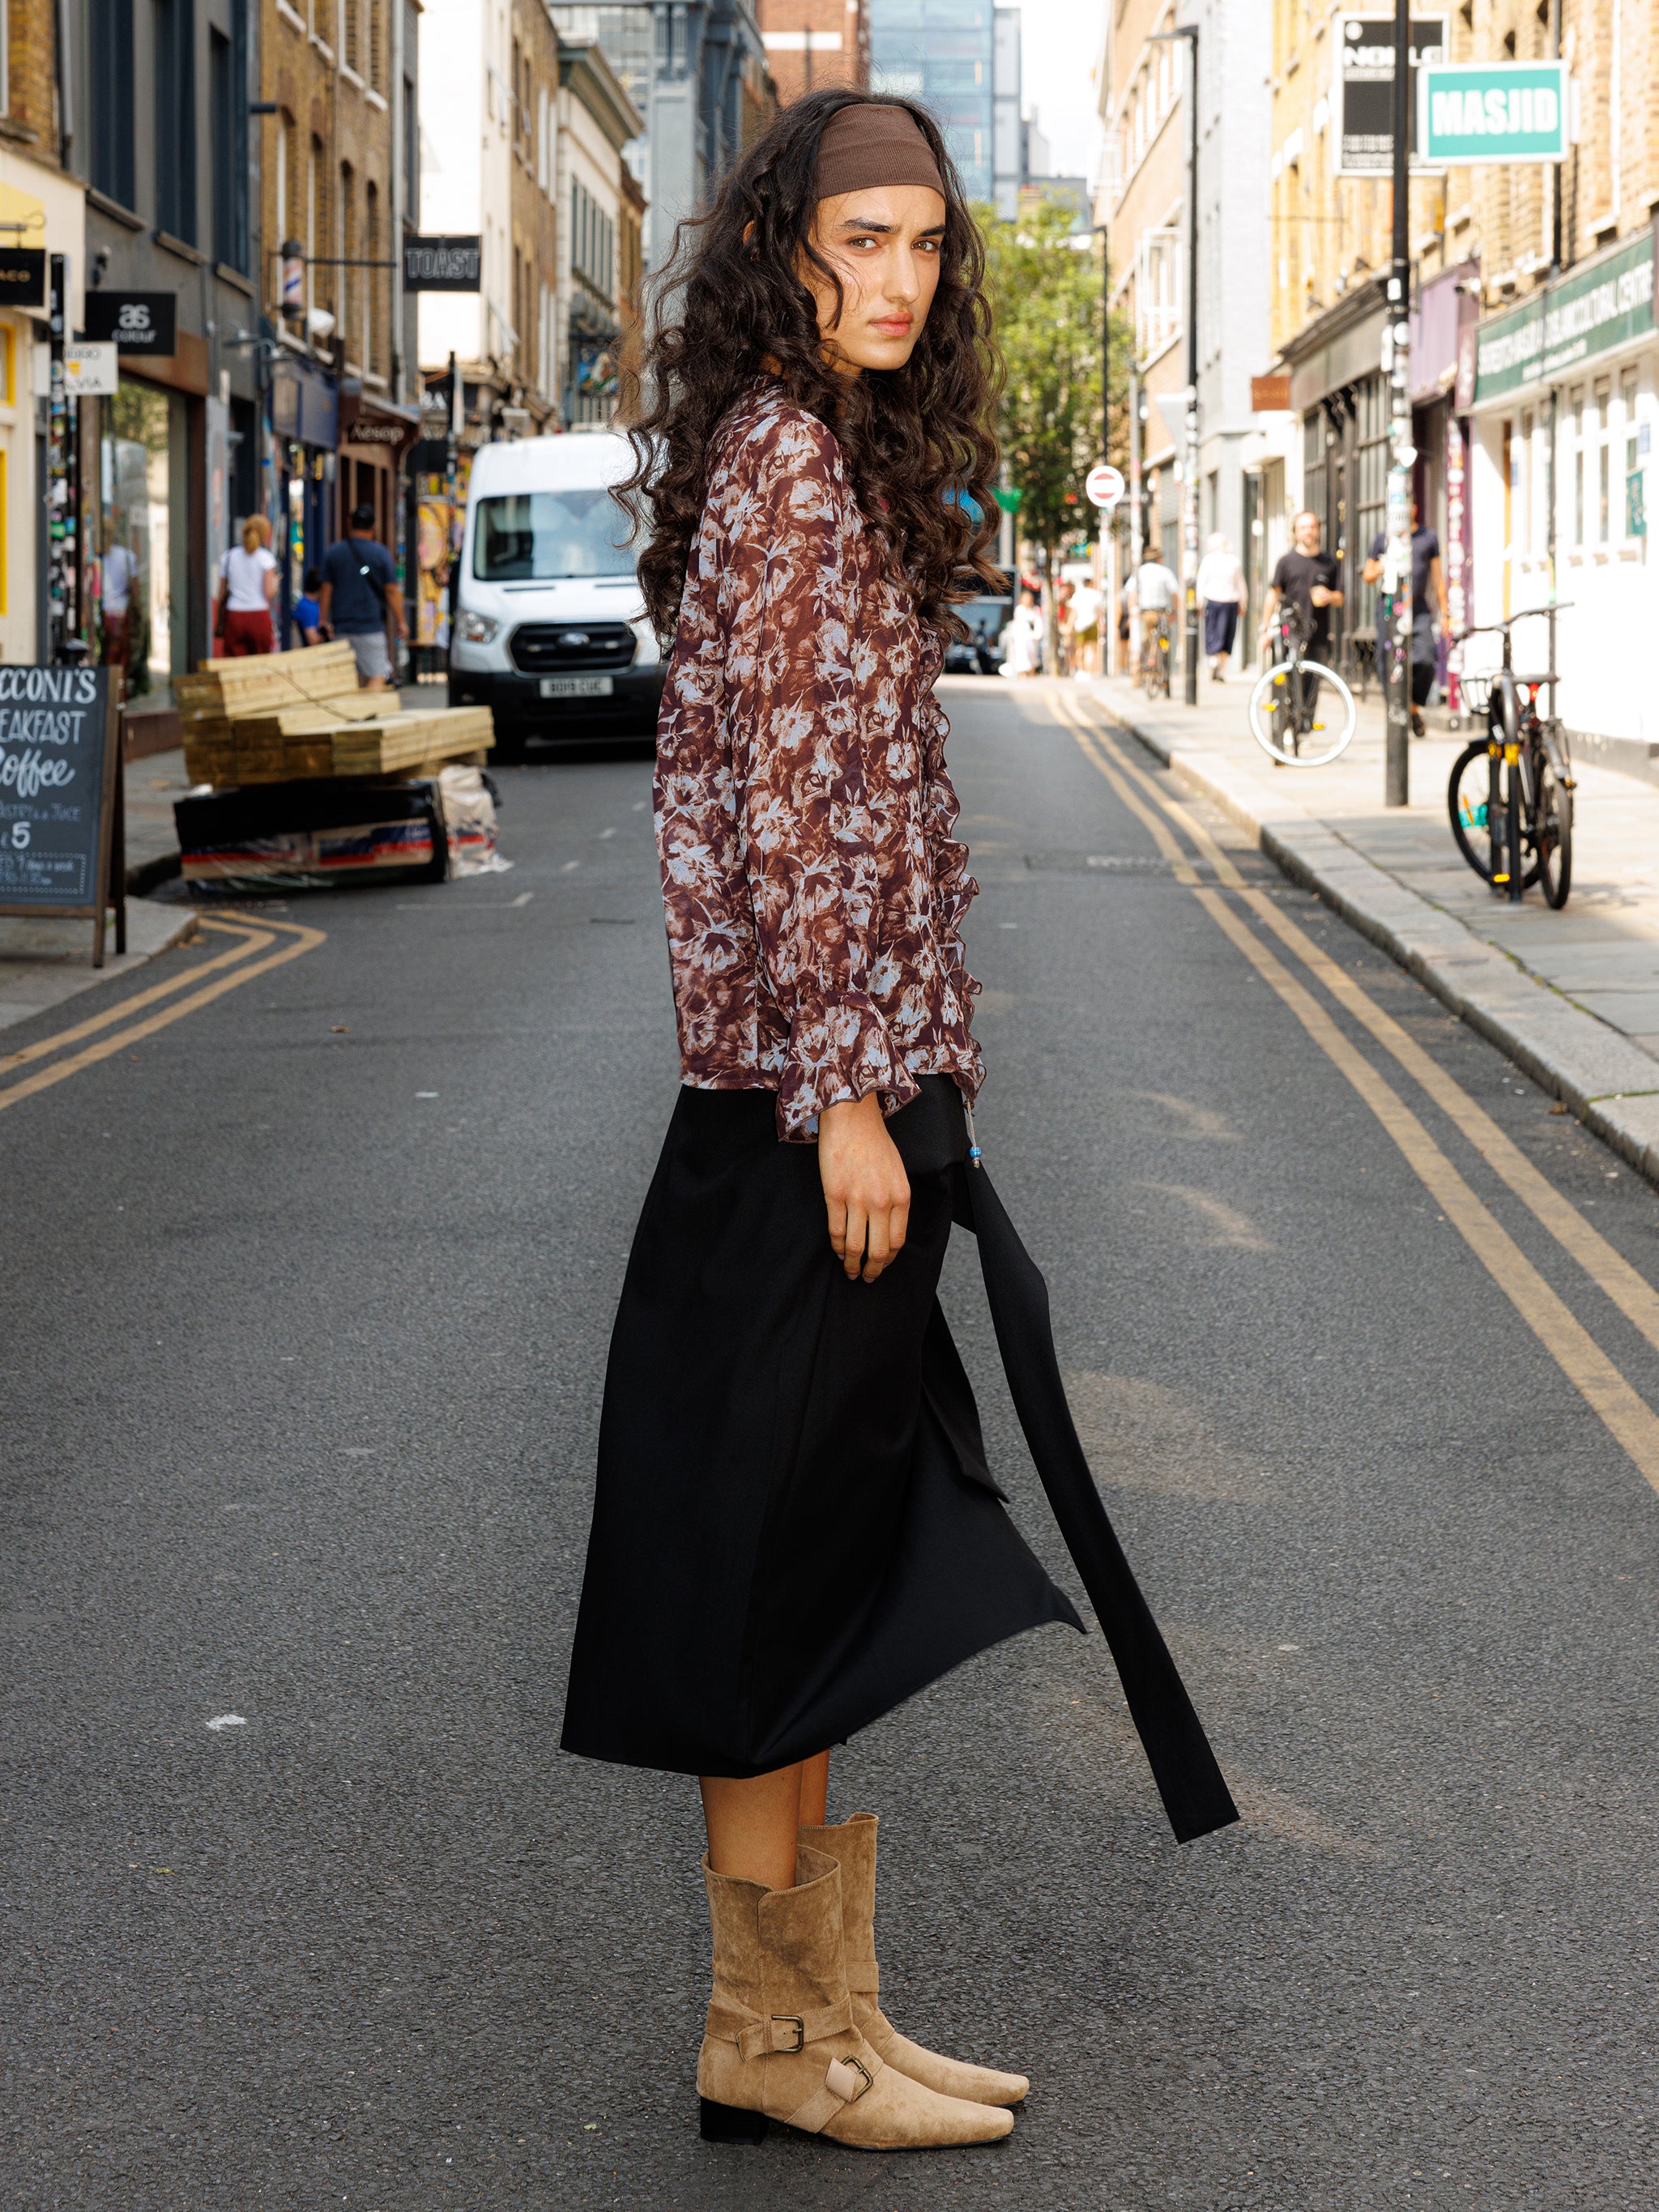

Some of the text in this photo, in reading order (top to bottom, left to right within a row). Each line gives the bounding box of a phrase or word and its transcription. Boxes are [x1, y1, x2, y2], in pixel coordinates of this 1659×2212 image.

[1432, 88, 1559, 136] MASJID
[406, 248, 480, 278] TOAST
[112, 329, 156, 343] colour
[351, 426, 403, 445] Aesop
[0, 746, 75, 798] offee
